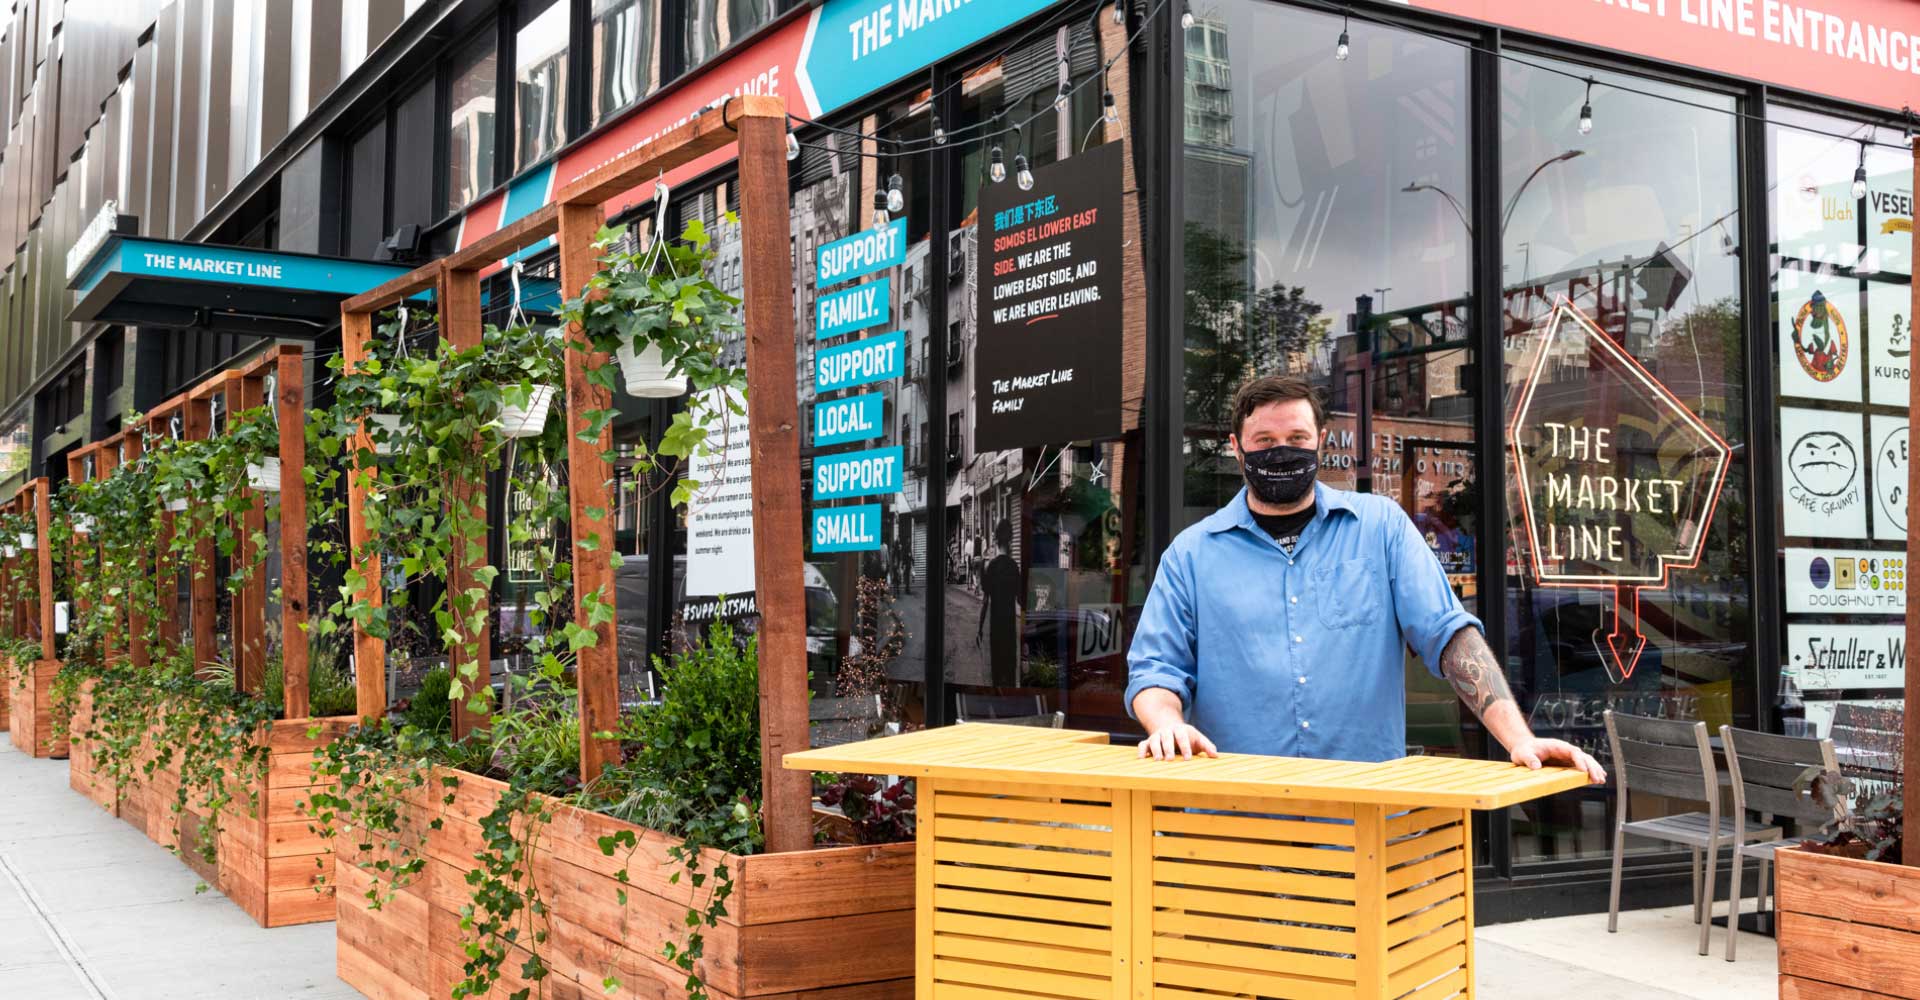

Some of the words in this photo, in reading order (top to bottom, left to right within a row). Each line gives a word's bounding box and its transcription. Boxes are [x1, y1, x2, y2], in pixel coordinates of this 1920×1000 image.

[849, 3, 893, 62] THE
[1823, 194, 1853, 220] Wah
[994, 230, 1026, 253] SOMOS
[1027, 227, 1037, 243] EL
[1039, 217, 1071, 240] LOWER
[1073, 208, 1098, 229] EAST
[144, 253, 175, 270] THE
[178, 257, 244, 276] MARKET
[247, 263, 282, 279] LINE
[821, 227, 898, 280] SUPPORT
[993, 258, 1016, 276] SIDE.
[1018, 253, 1032, 270] WE
[1033, 247, 1051, 265] ARE
[1053, 241, 1071, 260] THE
[993, 280, 1024, 300] LOWER
[1025, 273, 1049, 292] EAST
[1049, 267, 1074, 286] SIDE,
[1075, 260, 1097, 279] AND
[820, 286, 879, 330] FAMILY.
[993, 308, 1008, 324] WE
[1008, 303, 1026, 320] ARE
[1027, 296, 1057, 316] NEVER
[1058, 286, 1101, 309] LEAVING.
[819, 341, 896, 386] SUPPORT
[818, 401, 873, 437] LOCAL.
[1544, 423, 1611, 463] THE
[817, 456, 895, 494] SUPPORT
[1547, 473, 1684, 515] MARKET
[1821, 485, 1859, 517] GRUMPY
[816, 513, 874, 545] SMALL.
[1549, 523, 1624, 562] LINE
[1809, 594, 1885, 607] DOUGHNUT
[1876, 653, 1886, 669] &
